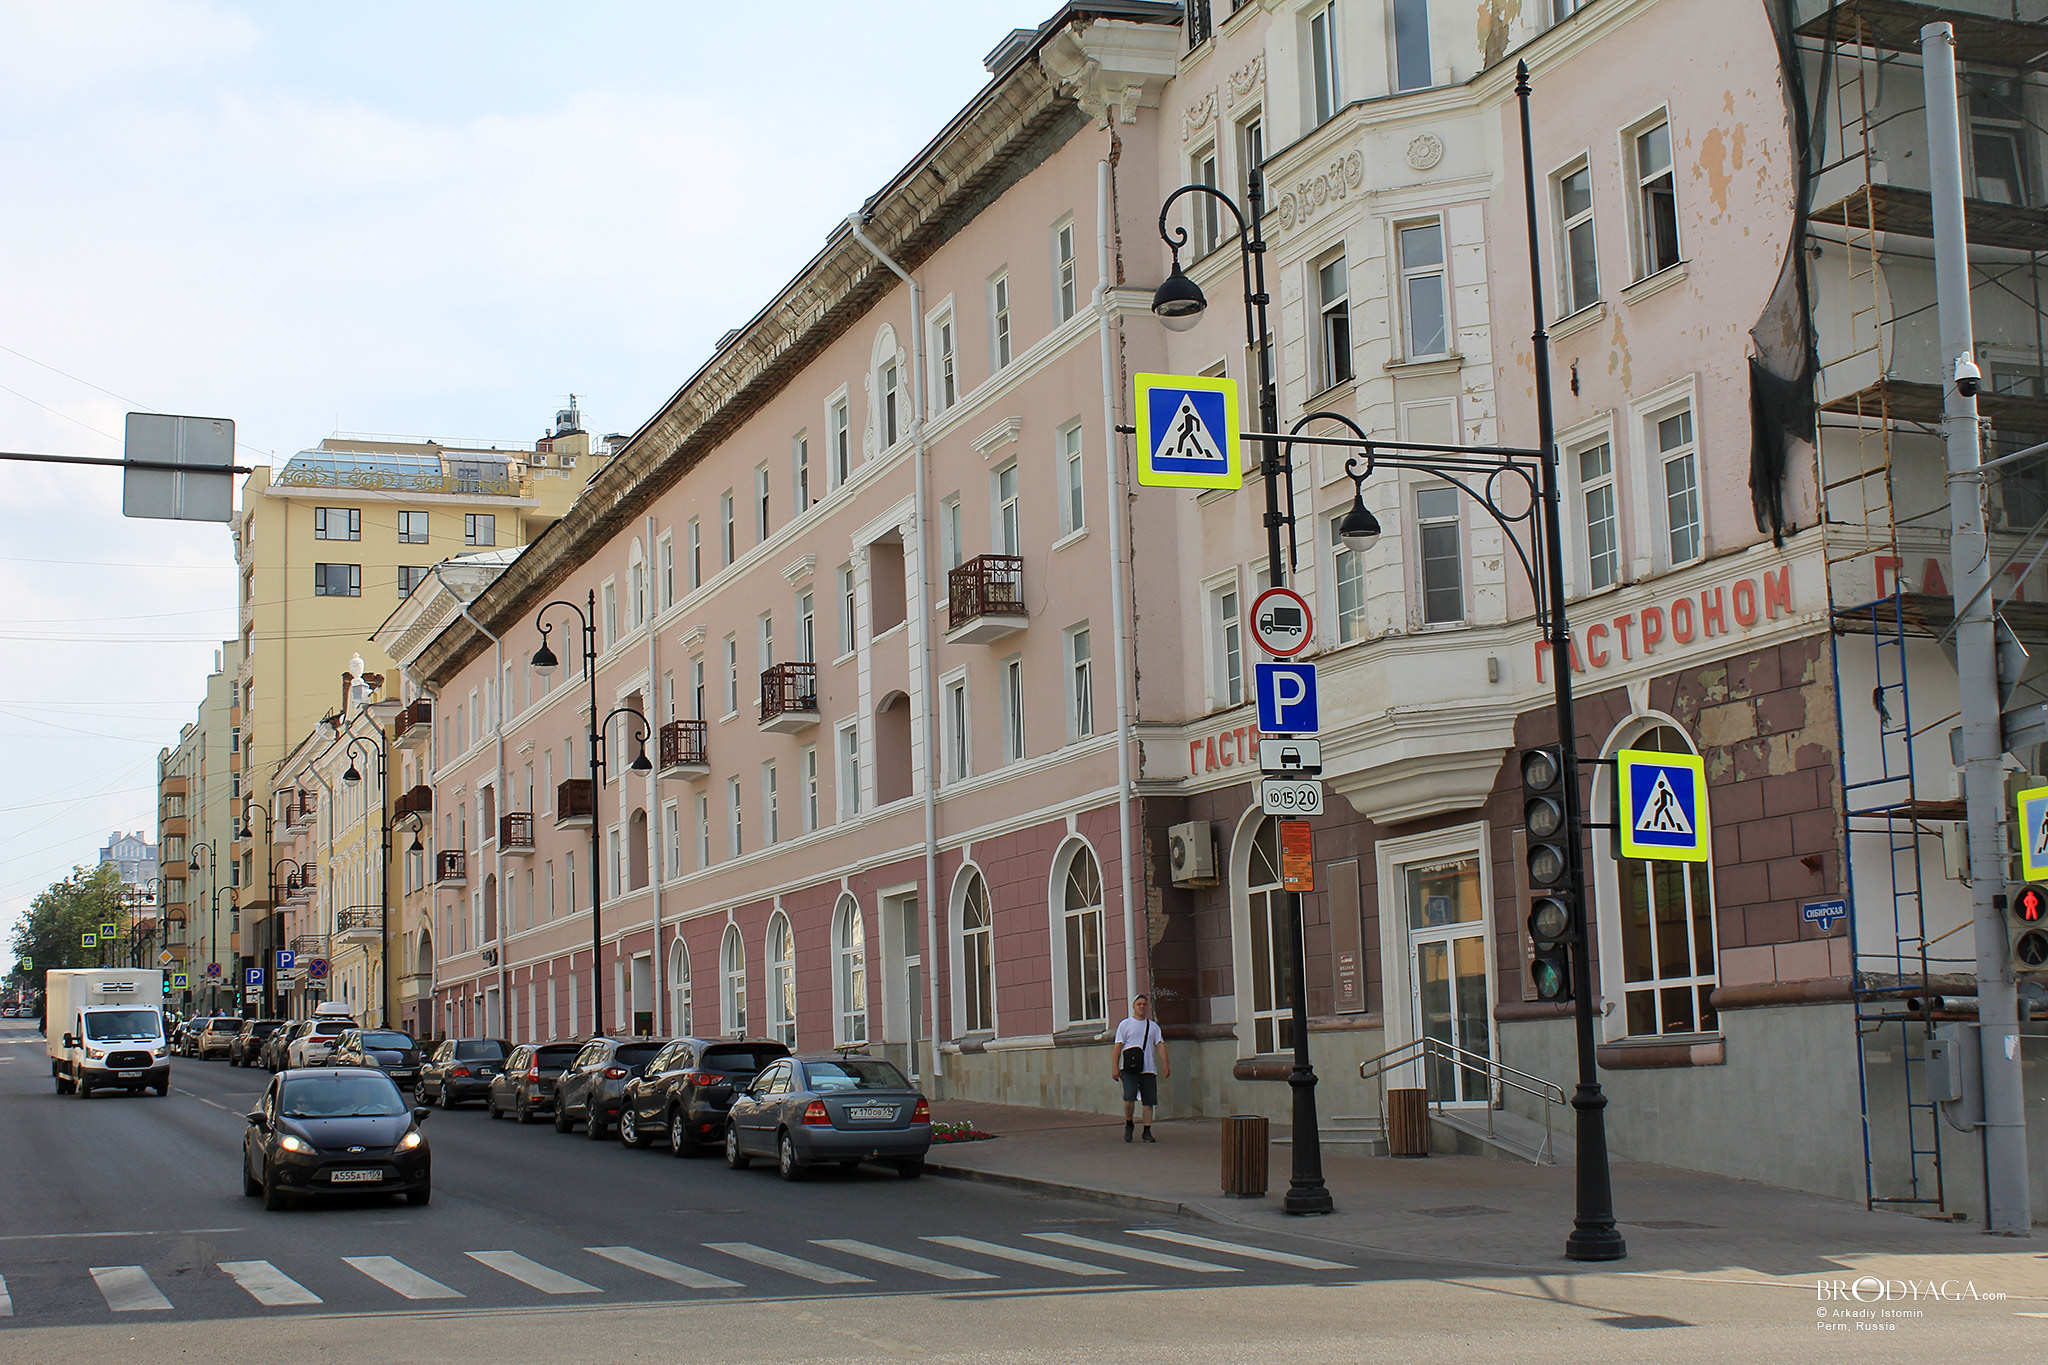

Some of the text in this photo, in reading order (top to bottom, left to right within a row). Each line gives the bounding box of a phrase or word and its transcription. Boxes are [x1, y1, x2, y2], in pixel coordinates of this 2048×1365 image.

[1272, 671, 1306, 724] P
[1270, 790, 1316, 805] 10 15 20
[1806, 906, 1843, 918] СИБИРСКАЯ
[1822, 918, 1828, 929] 1
[281, 953, 292, 967] P
[250, 970, 260, 983] P
